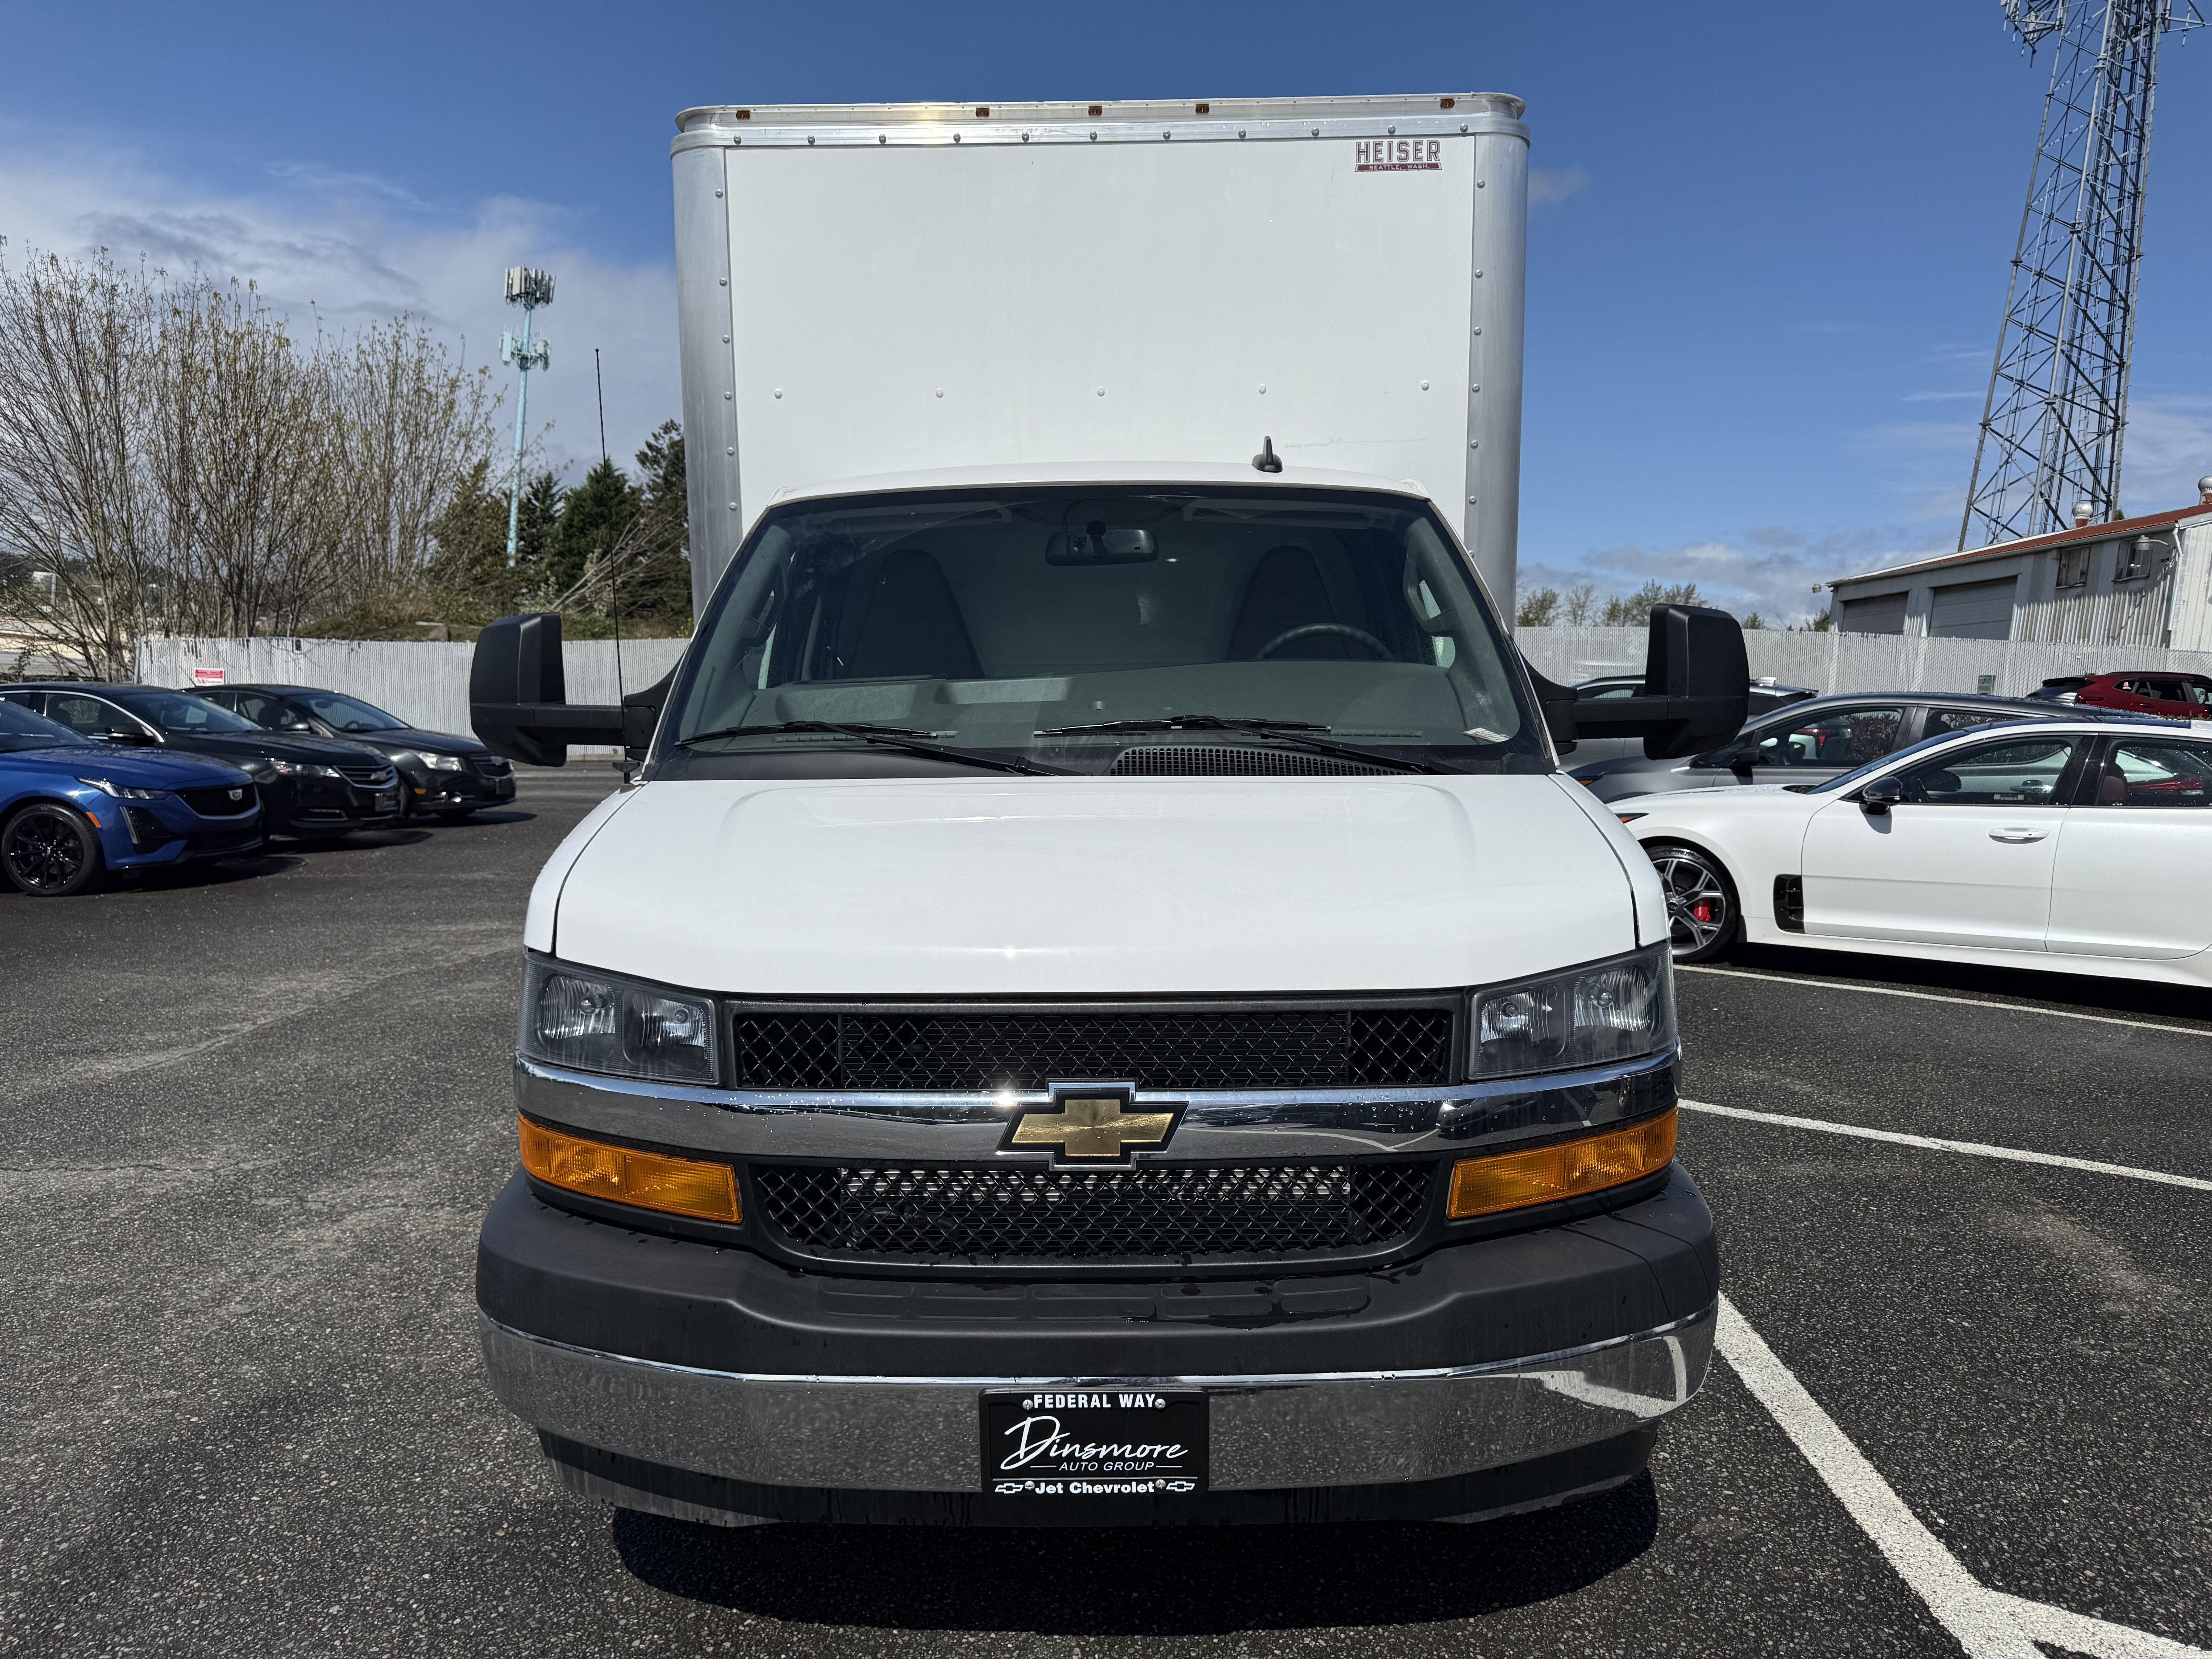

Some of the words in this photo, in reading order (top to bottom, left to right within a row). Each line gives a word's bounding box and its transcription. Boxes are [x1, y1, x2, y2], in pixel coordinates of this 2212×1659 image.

[1356, 140, 1440, 163] HEISER
[1034, 1394, 1111, 1408] FEDERAL
[1119, 1394, 1156, 1408] WAY
[1000, 1415, 1188, 1470] Dinsmore
[1059, 1462, 1098, 1471] AUTO
[1103, 1462, 1154, 1471] GROUP
[1035, 1482, 1063, 1494] Jet
[1069, 1481, 1154, 1494] Chevrolet
